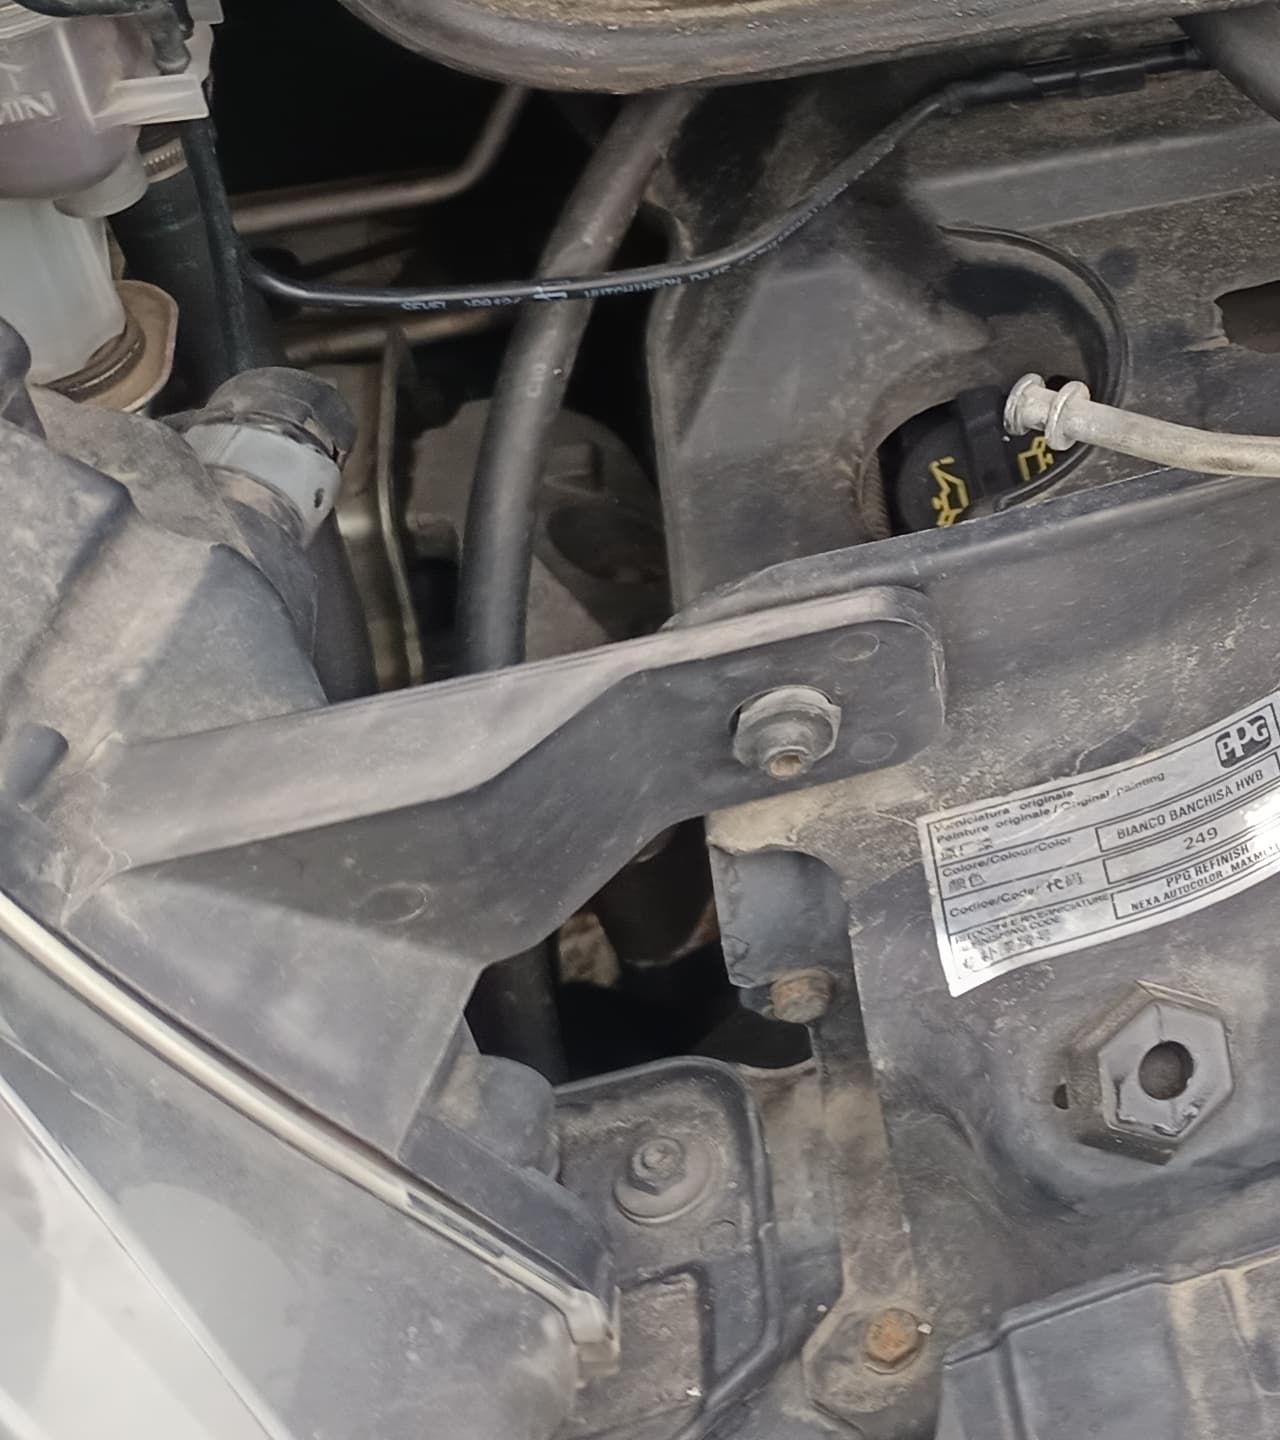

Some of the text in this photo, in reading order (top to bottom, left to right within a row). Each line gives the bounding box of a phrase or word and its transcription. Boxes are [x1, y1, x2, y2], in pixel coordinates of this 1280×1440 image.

[1216, 718, 1270, 761] PPG
[1018, 788, 1074, 812] originale
[1115, 768, 1264, 840] BIANCO BANCHISA HWB
[1181, 825, 1220, 850] 249
[1164, 843, 1250, 887] PPG REFINISH
[1129, 894, 1161, 911] NEXA
[1161, 869, 1223, 900] AUTOCOLOR
